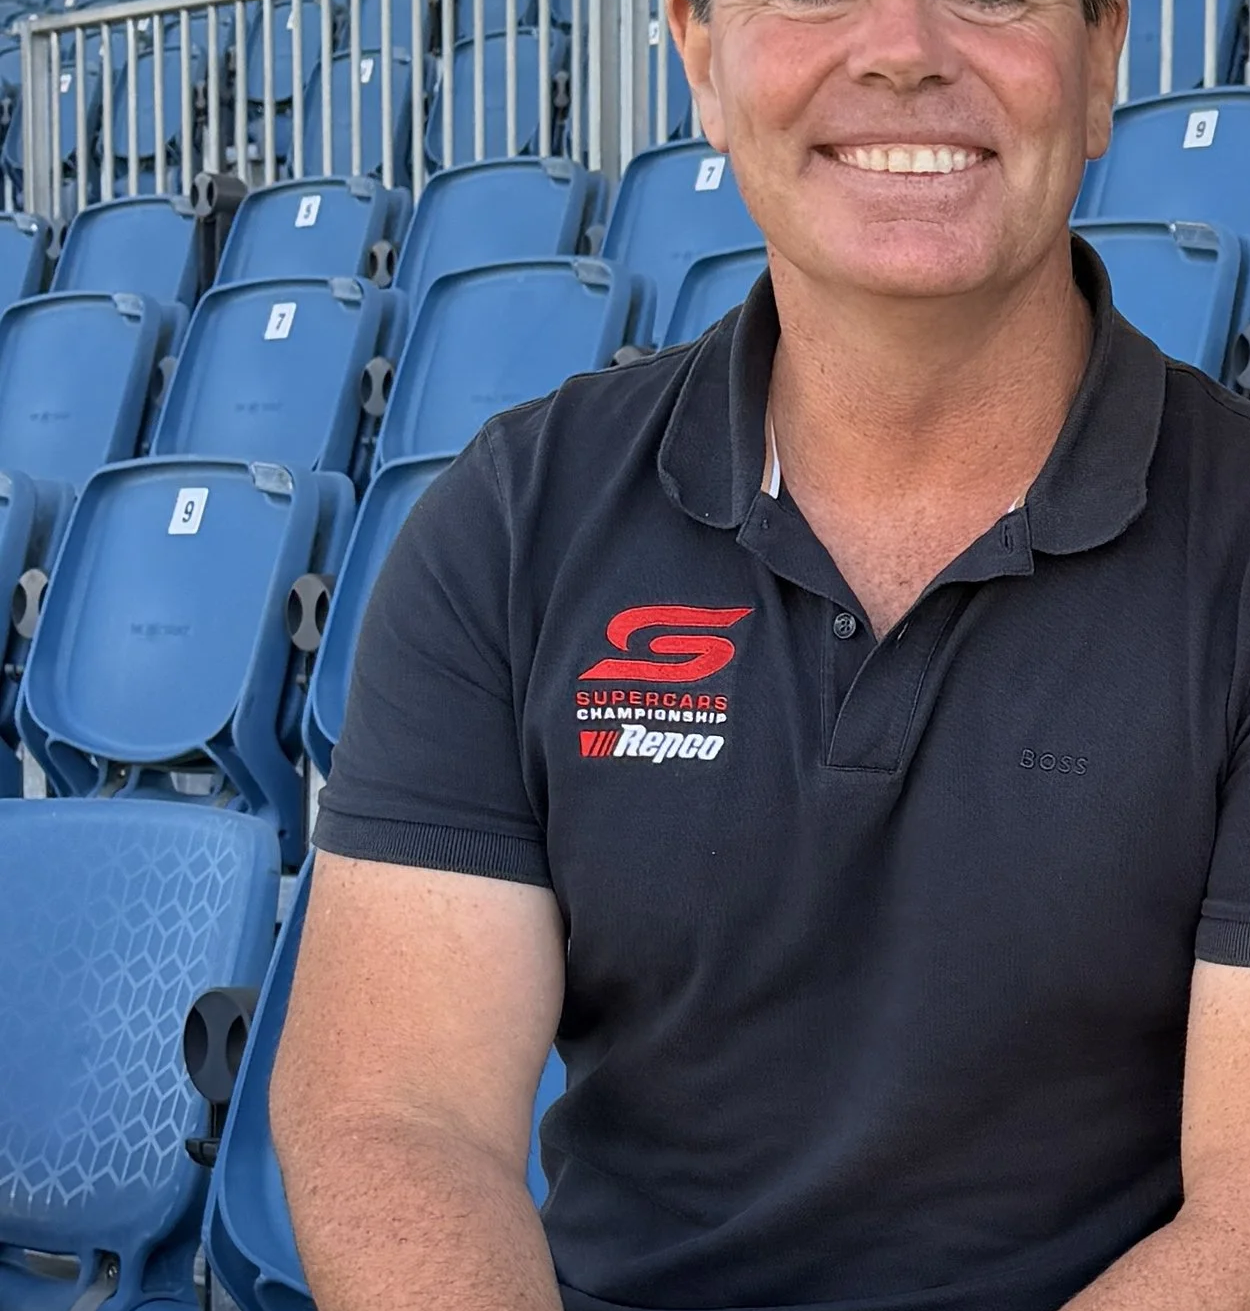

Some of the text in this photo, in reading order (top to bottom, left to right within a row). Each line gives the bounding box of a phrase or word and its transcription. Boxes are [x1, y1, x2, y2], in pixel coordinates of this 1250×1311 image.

[1195, 121, 1206, 139] 9
[706, 166, 716, 182] 7
[275, 312, 287, 331] 7
[181, 500, 195, 524] 9
[575, 689, 729, 712] SUPERCARS
[575, 707, 728, 724] CHAMPIONSHIP
[612, 723, 726, 764] Repco
[1020, 749, 1088, 776] BOSS
